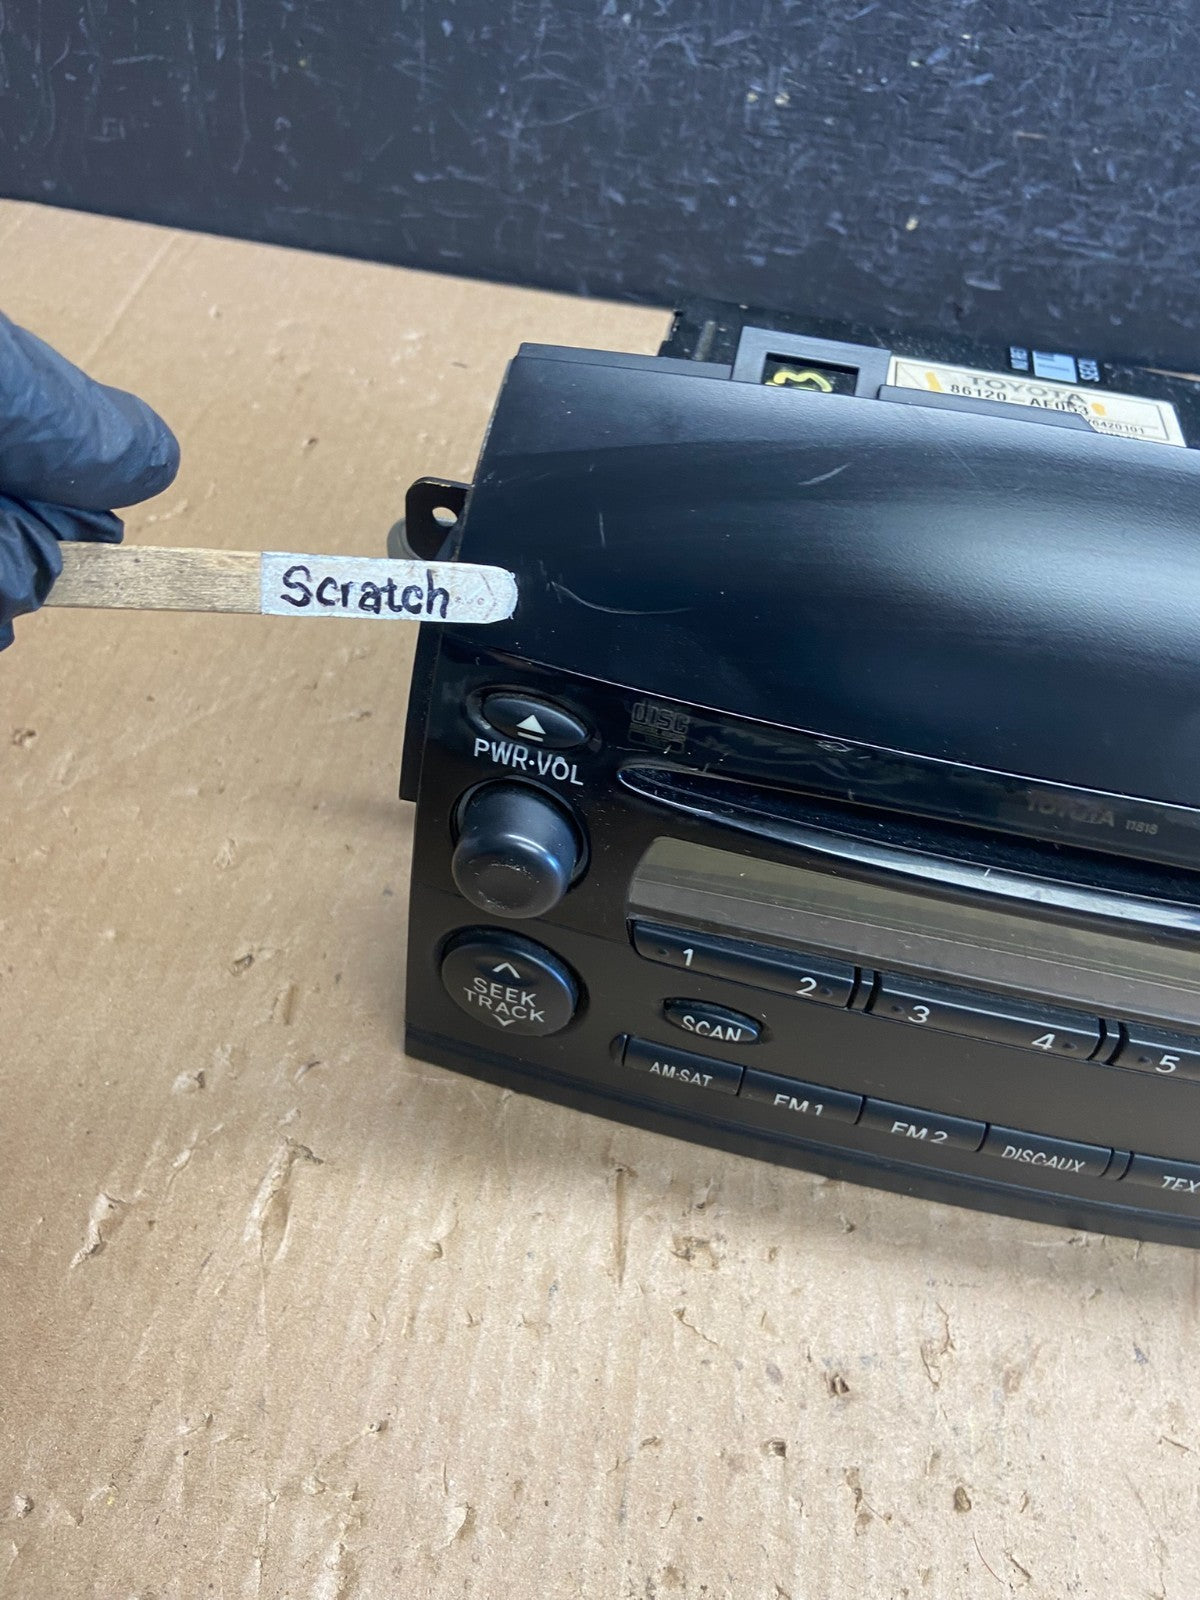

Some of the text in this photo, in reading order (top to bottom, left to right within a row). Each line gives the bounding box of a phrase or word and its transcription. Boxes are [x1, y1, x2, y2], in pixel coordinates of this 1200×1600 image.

[968, 376, 1087, 404] TOYOTA
[280, 564, 450, 619] Scratch
[682, 948, 695, 967] 1
[472, 976, 537, 1008] SEEK
[796, 976, 817, 998] 2
[463, 986, 546, 1023] TRACK
[907, 1005, 931, 1024] 3
[681, 1014, 742, 1043] SCAN
[1031, 1032, 1054, 1050] 4
[1156, 1054, 1180, 1074] 5
[773, 1093, 825, 1117] FM 1
[890, 1120, 949, 1145] FM 2
